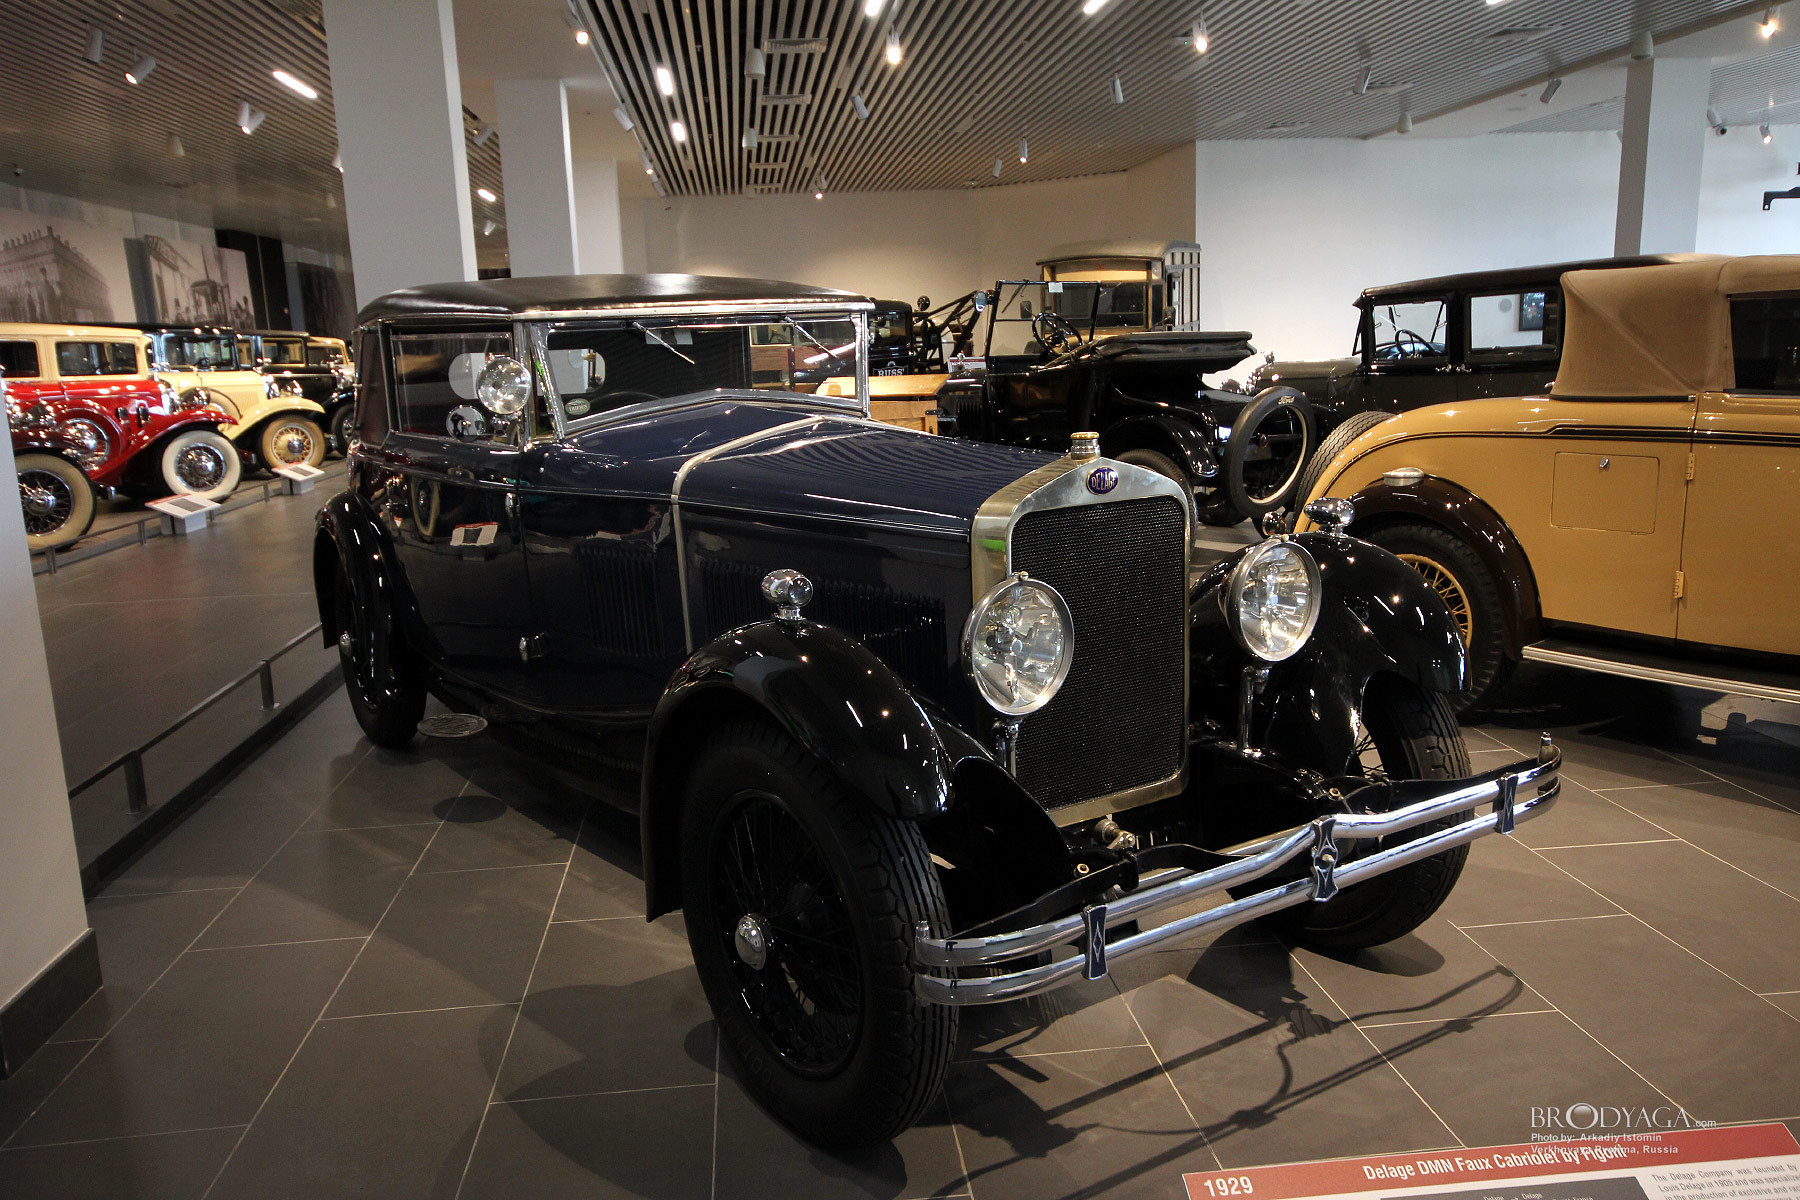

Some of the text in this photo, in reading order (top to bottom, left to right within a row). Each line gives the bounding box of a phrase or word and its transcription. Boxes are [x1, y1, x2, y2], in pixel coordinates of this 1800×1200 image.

[1203, 1144, 1628, 1197] 1929 Delage DMN Faux Cabriolet by Figoni
[1669, 1172, 1697, 1181] Delage
[1697, 1169, 1733, 1179] Company
[1753, 1165, 1786, 1174] founded
[1786, 1164, 1798, 1172] by
[1657, 1184, 1680, 1192] Louis
[1679, 1181, 1706, 1191] Delage
[1705, 1180, 1714, 1188] in
[1734, 1178, 1749, 1186] and
[1763, 1173, 1800, 1184] specialize
[1686, 1190, 1729, 1200] production
[1728, 1189, 1738, 1198] of
[1737, 1187, 1774, 1197] exclusive
[1772, 1185, 1788, 1194] and
